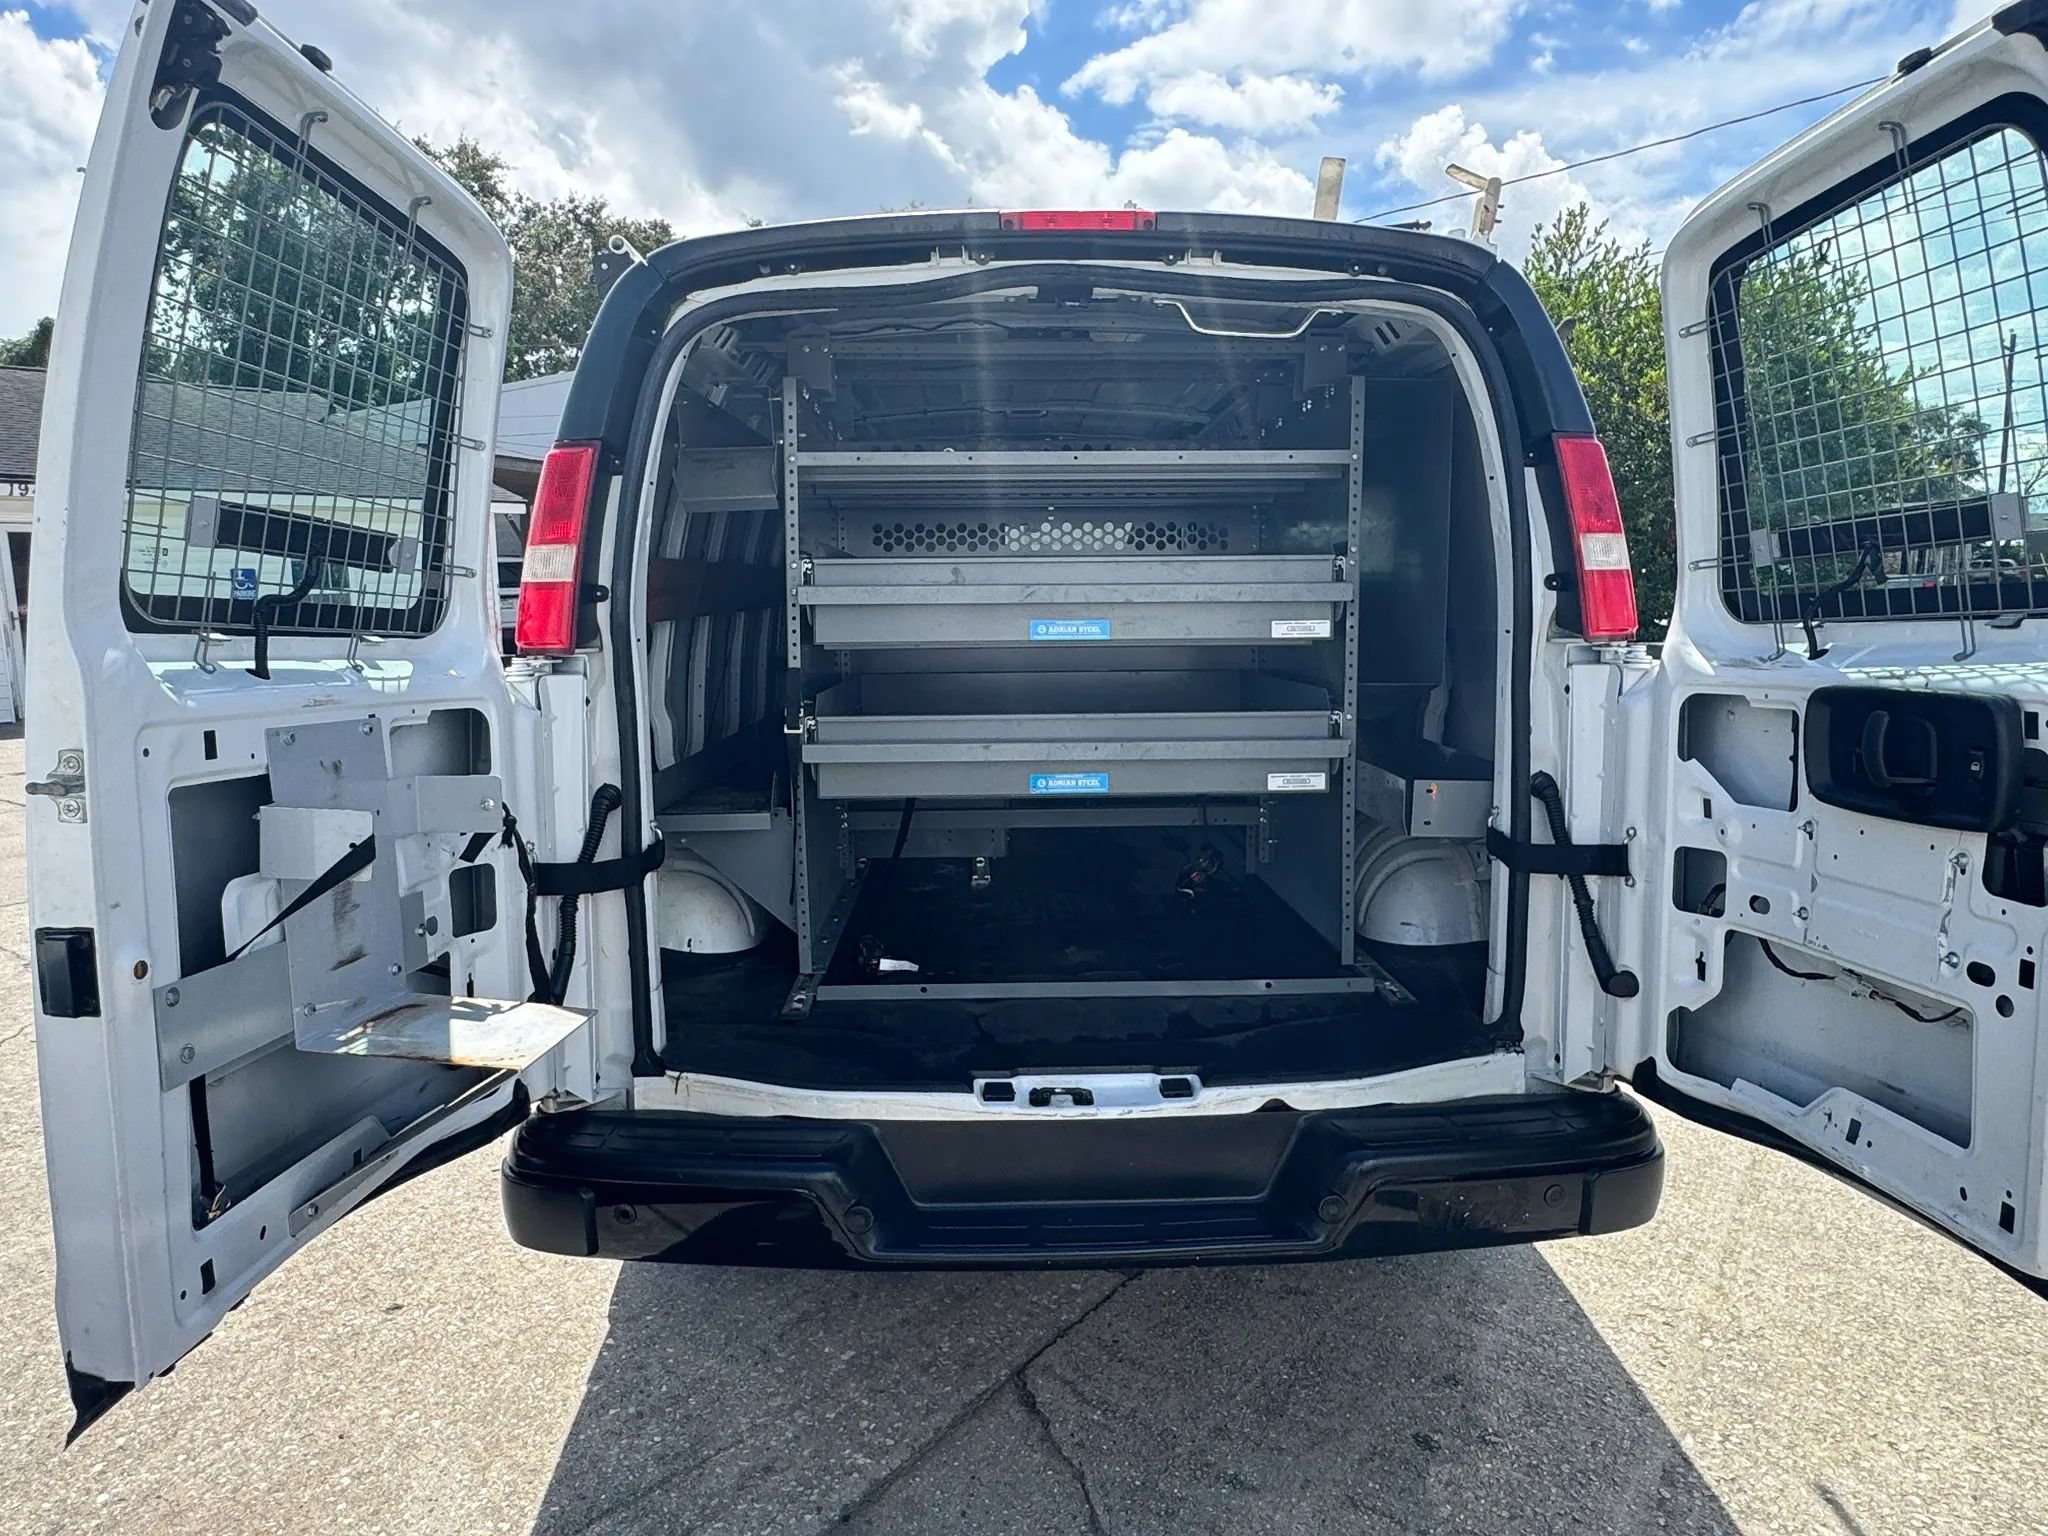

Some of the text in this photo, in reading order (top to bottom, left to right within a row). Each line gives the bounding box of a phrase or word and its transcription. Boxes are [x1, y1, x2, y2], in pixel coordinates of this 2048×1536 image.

[8, 482, 36, 497] 19
[1048, 625, 1101, 633] ADRIAN STEEL
